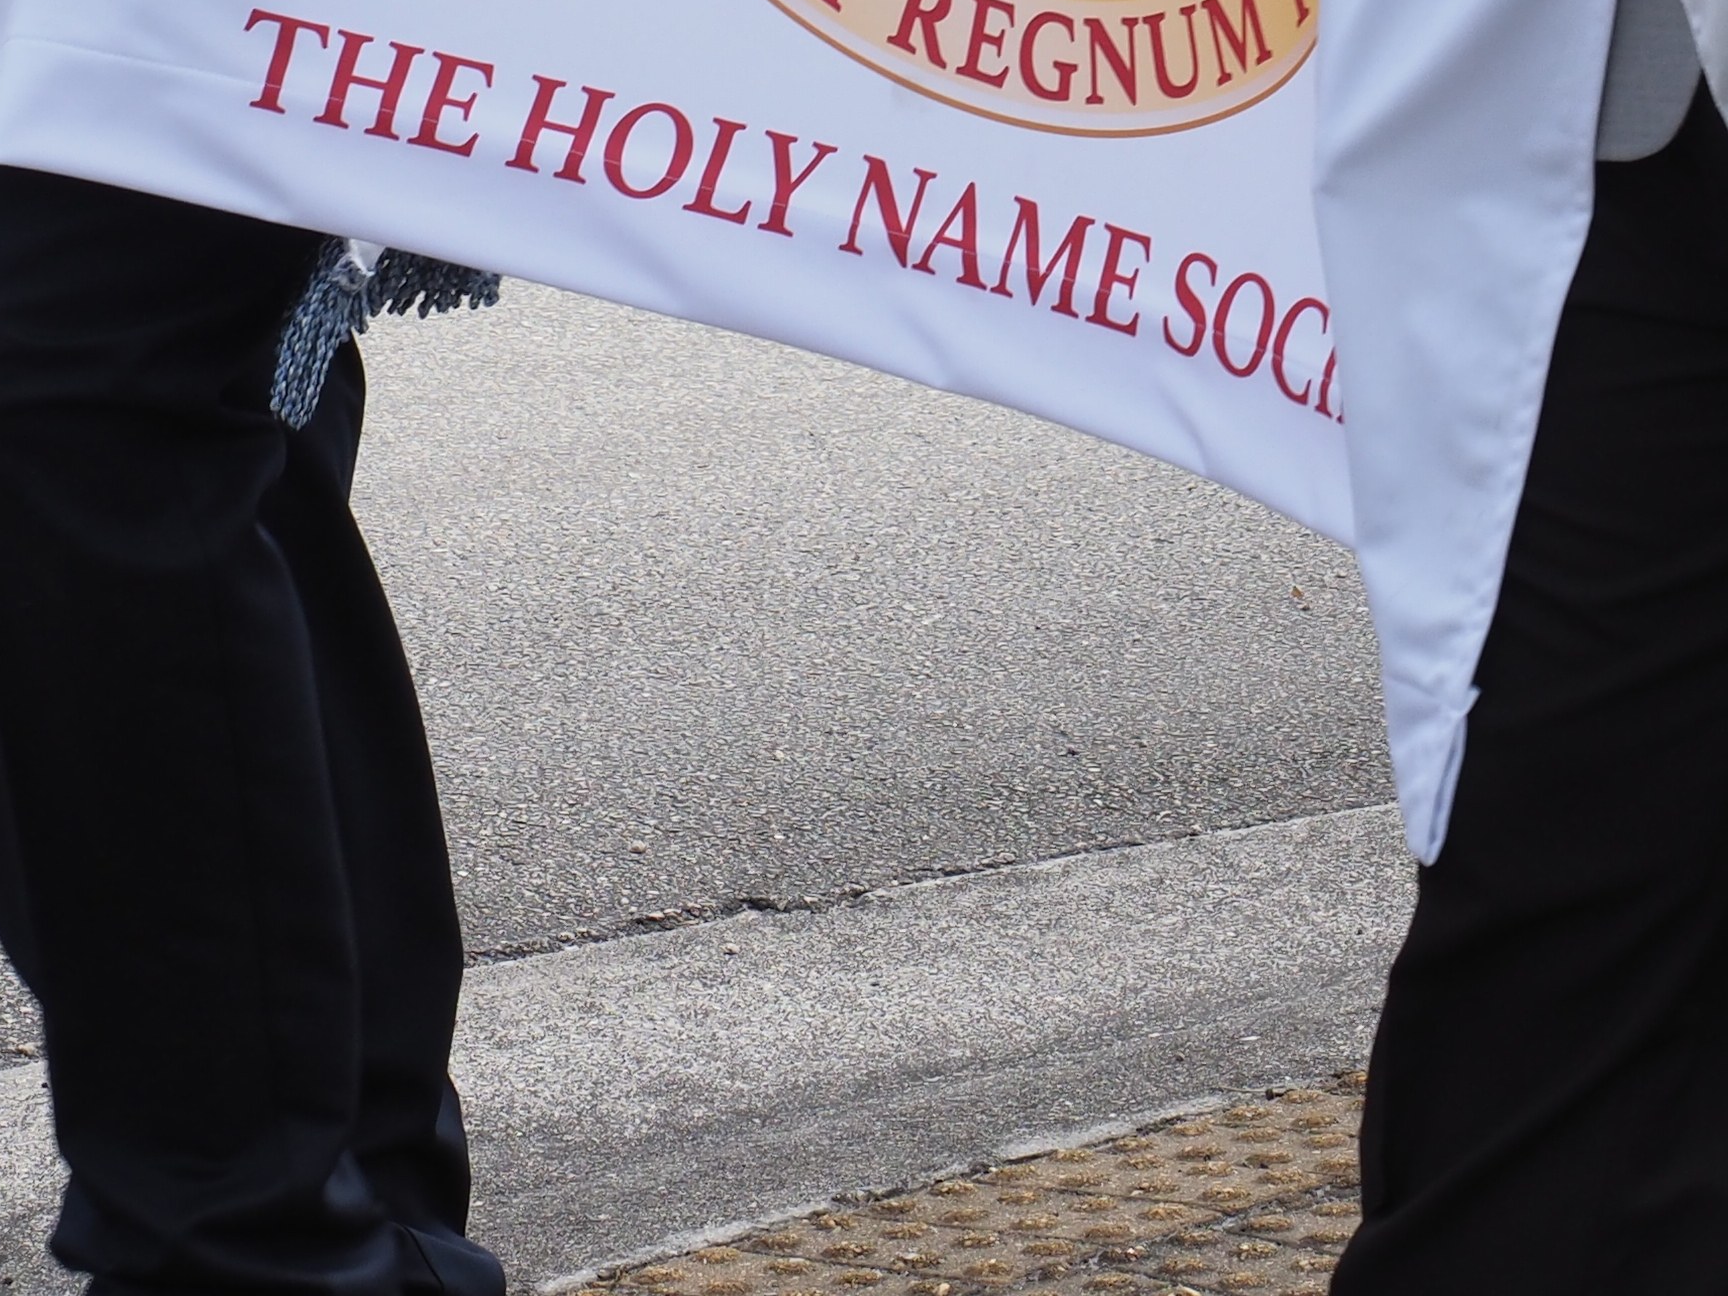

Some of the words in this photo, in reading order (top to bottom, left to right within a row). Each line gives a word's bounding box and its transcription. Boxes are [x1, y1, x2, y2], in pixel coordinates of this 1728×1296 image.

[244, 7, 495, 159] THE
[504, 73, 839, 239] HOLY
[838, 153, 1152, 338] NAME
[1162, 251, 1345, 425] SOCI
